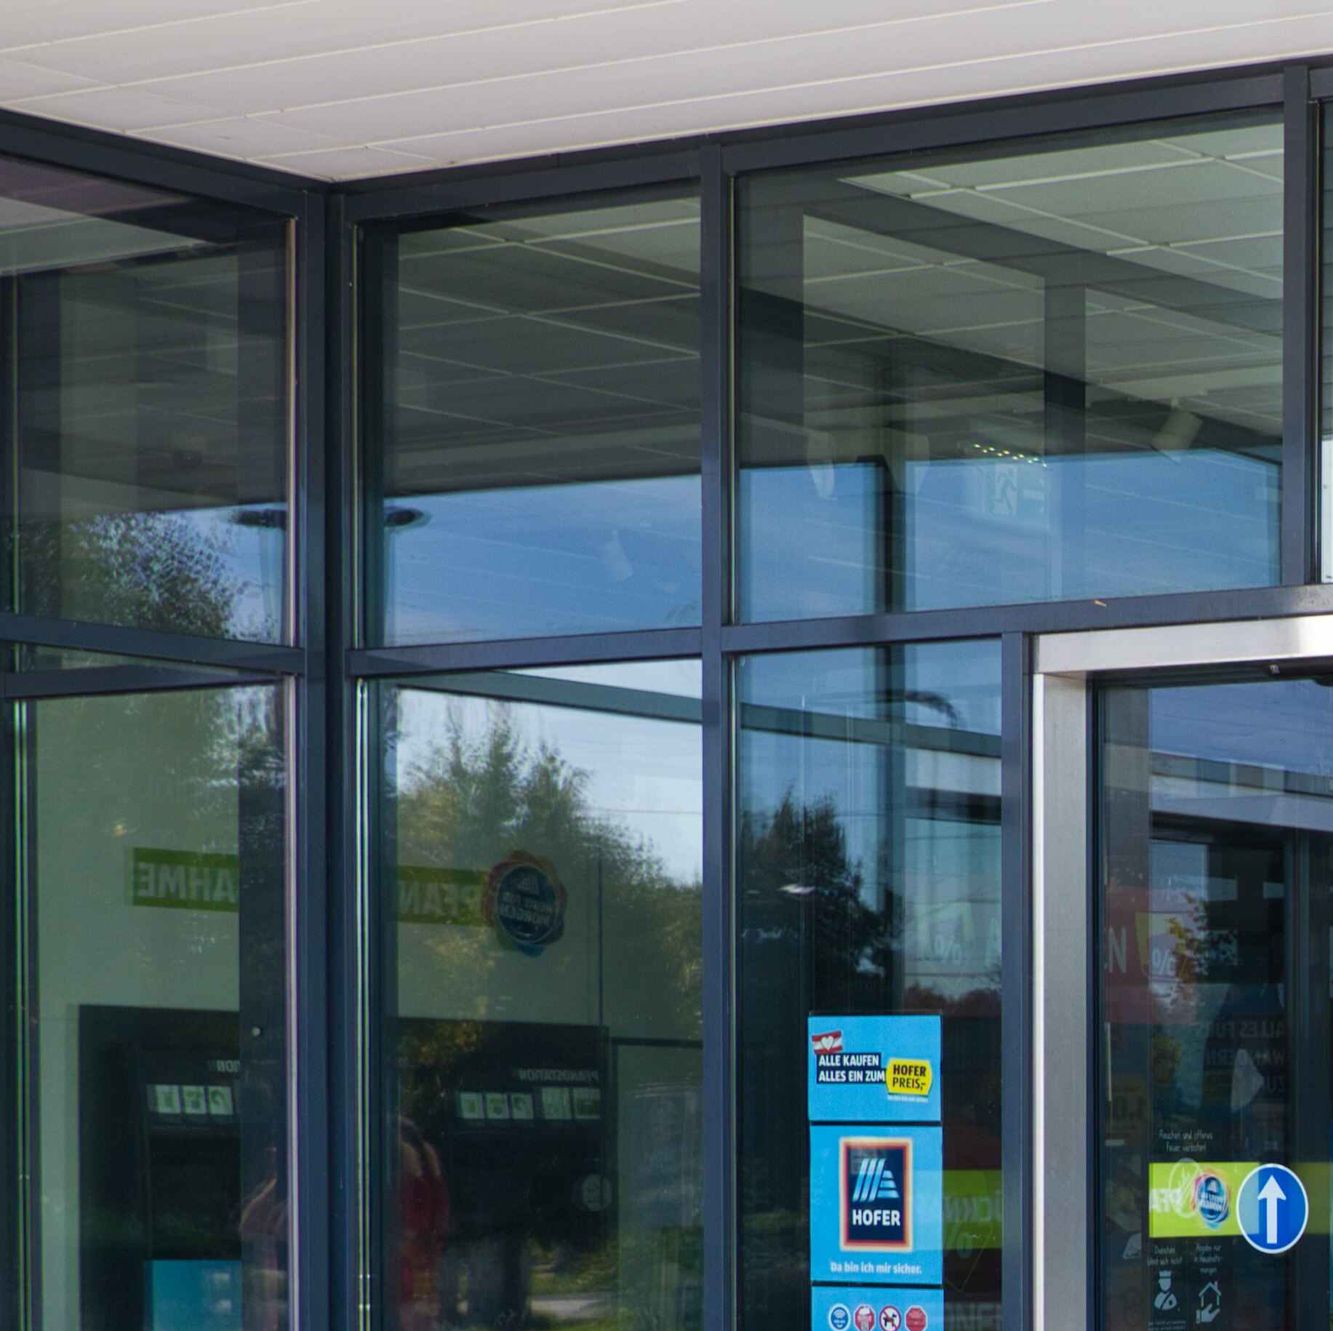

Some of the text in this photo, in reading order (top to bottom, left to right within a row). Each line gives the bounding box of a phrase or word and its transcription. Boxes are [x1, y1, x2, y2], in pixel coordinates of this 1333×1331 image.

[819, 1055, 879, 1066] ALLE KAUFEN
[819, 1070, 885, 1083] ALLES EIN ZUM
[893, 1064, 926, 1077] HOFER
[852, 1210, 901, 1226] HOFER
[844, 1261, 859, 1272] bin
[861, 1261, 874, 1273] ich
[876, 1262, 891, 1273] mir
